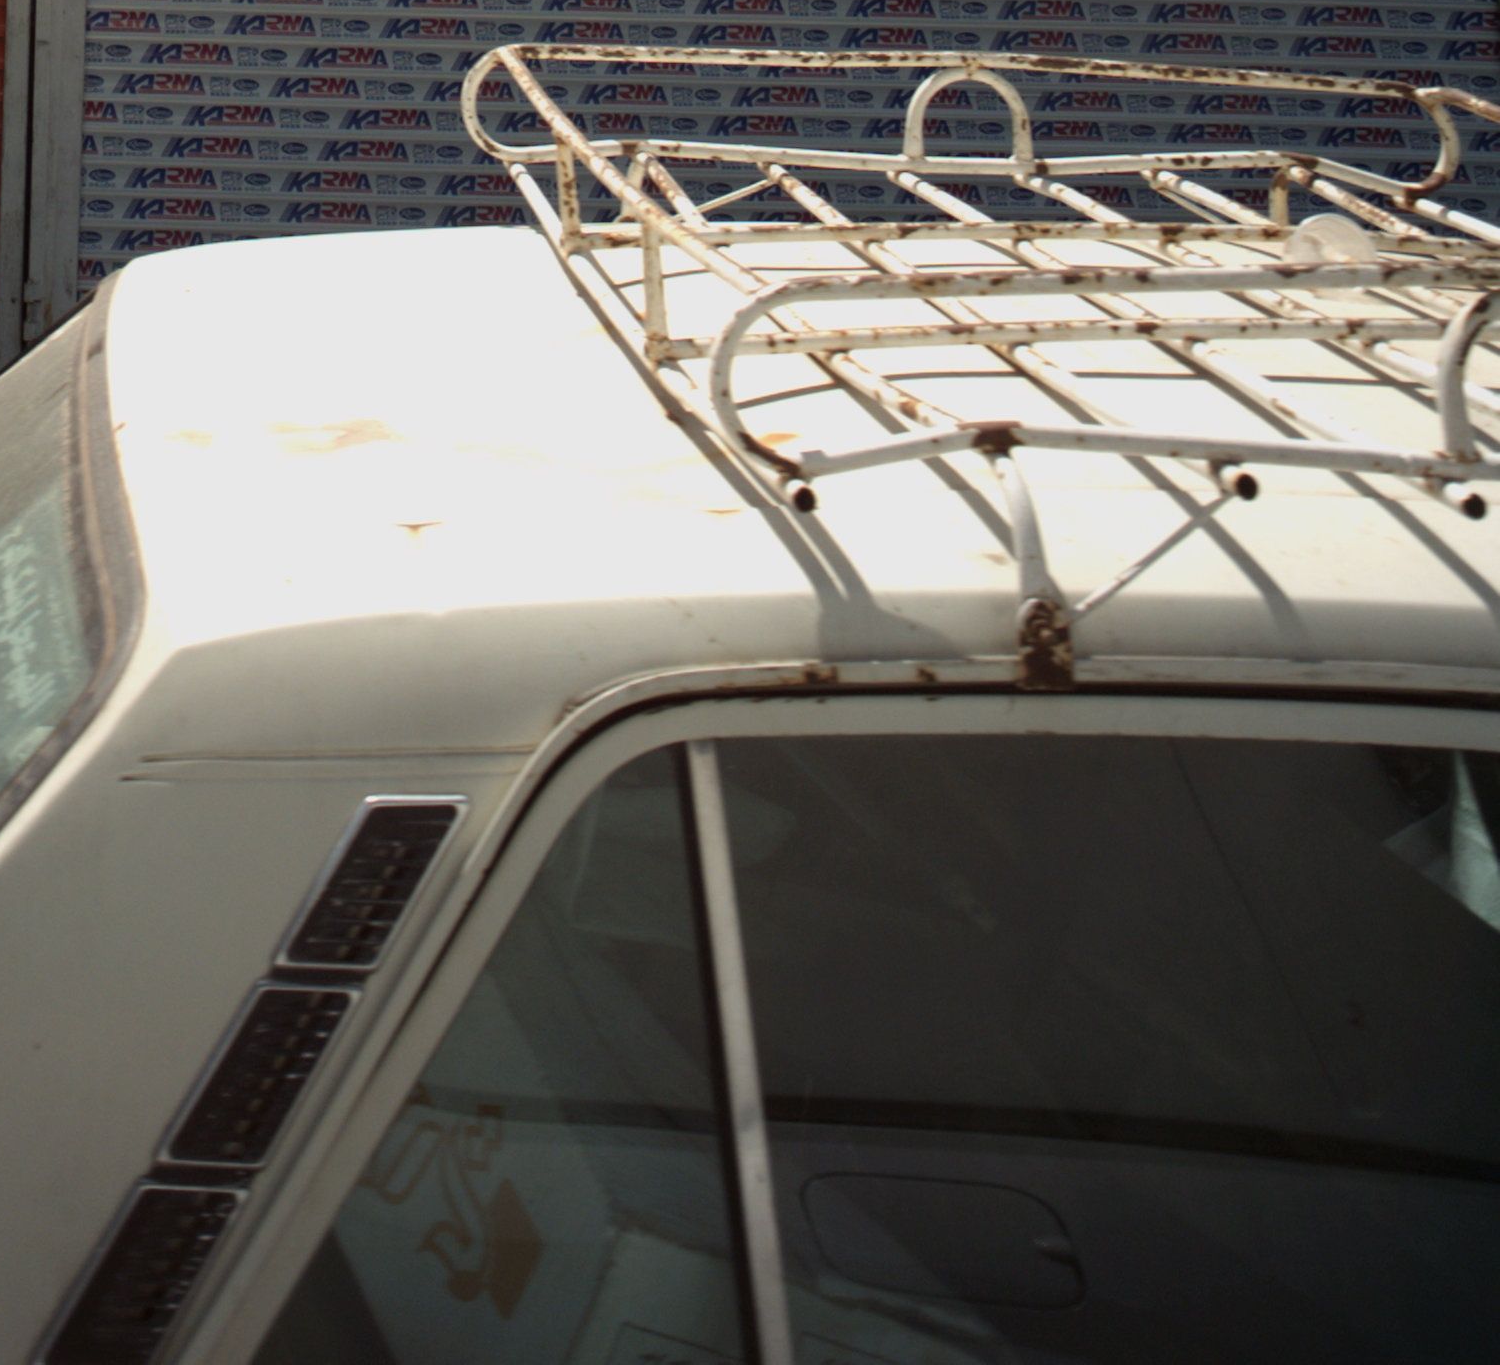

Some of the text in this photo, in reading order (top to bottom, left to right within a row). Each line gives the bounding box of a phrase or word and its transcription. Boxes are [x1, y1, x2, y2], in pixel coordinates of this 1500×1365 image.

[996, 0, 1086, 21] KARMA
[1145, 2, 1236, 24] KARMA
[1294, 5, 1384, 27] KARMA
[225, 13, 1376, 58] KARMA KARMA KARMA KARMA KARMA KARMA KARMA
[142, 42, 388, 68] KARMA KARMA
[114, 72, 360, 98] KARMA KARMA
[577, 83, 820, 107] KARMA KARMA
[184, 104, 430, 130] KARMA KARMA
[1033, 90, 1424, 119] KARMA KARMA KARMA
[707, 114, 798, 136] KARMA
[1164, 123, 1406, 148] KARMA KARMA
[163, 136, 254, 158] KARMA
[318, 139, 408, 161] KARMA
[126, 166, 216, 188] KARMA
[281, 170, 372, 192] KARMA
[280, 202, 370, 224] KARMA
